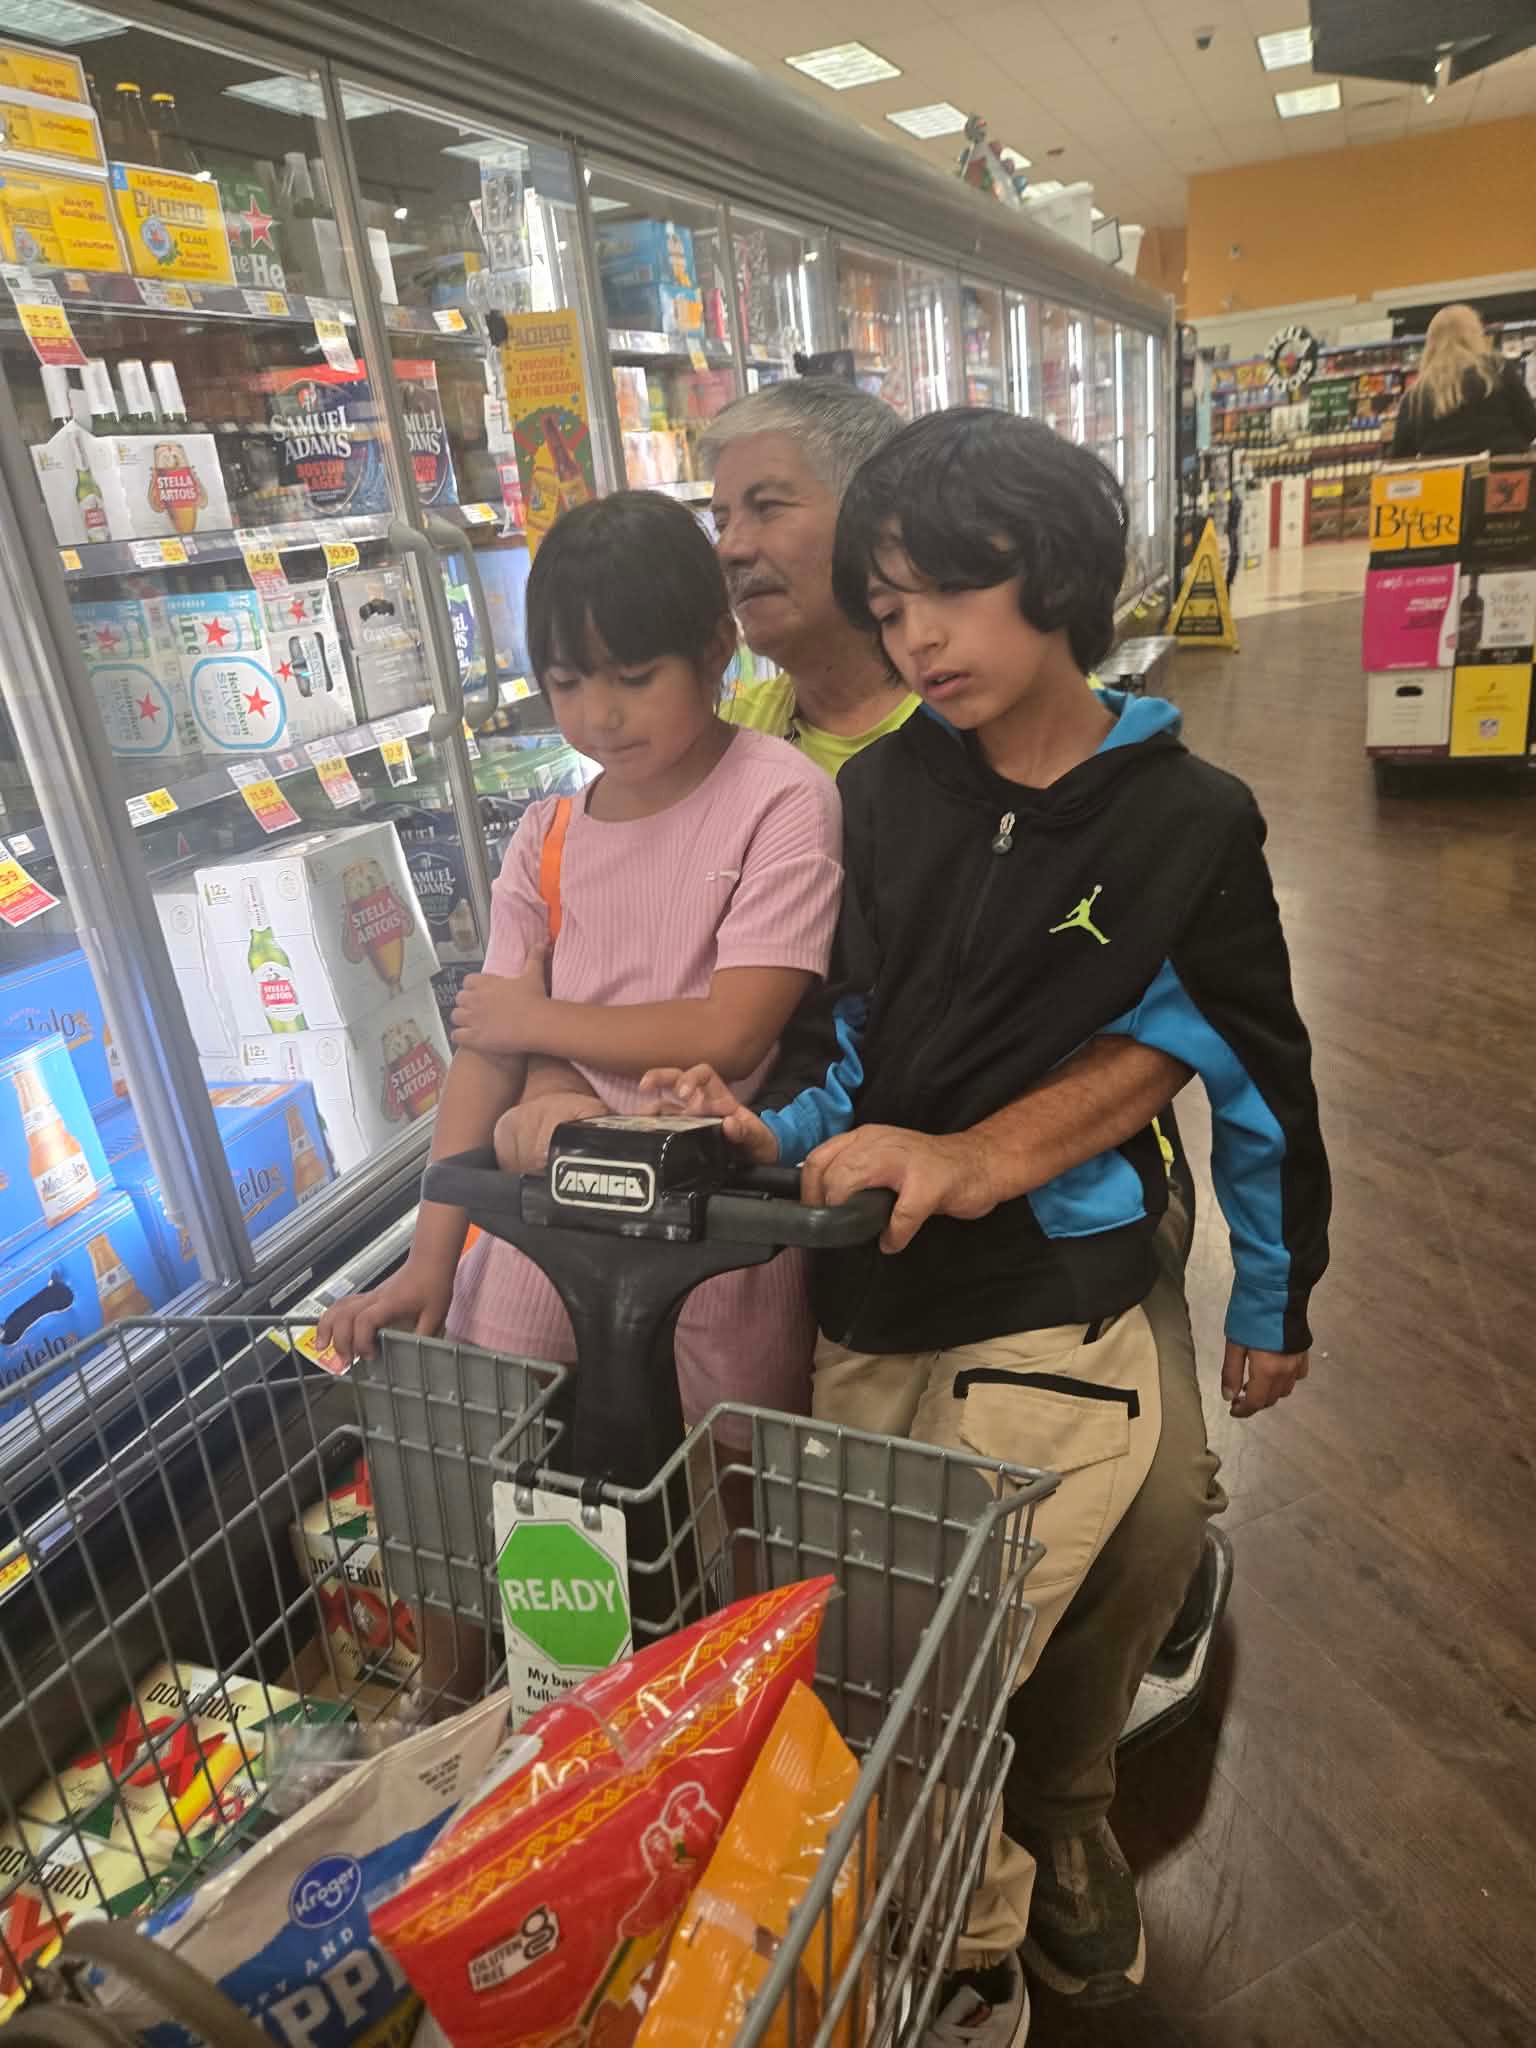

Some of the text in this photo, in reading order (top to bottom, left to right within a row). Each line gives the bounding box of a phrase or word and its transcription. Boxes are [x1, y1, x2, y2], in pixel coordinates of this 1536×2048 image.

[271, 404, 355, 442] SAMUEL
[403, 409, 442, 432] MUEL
[285, 432, 352, 465] ADAMS
[157, 473, 195, 489] STELLA
[159, 486, 197, 501] ARTOIS
[412, 867, 456, 883] AMUEL
[351, 896, 396, 929] STELLA
[356, 911, 402, 945] ARTOIS
[264, 984, 290, 994] STELLA
[391, 1051, 434, 1090] STELLA
[395, 1066, 438, 1104] ARTOIS
[239, 1167, 272, 1206] elo
[503, 1577, 617, 1614] READY
[527, 1666, 549, 1686] My
[296, 1866, 355, 1916] Kroger
[472, 1938, 523, 1975] GLUTEN
[475, 1966, 505, 1988] FREE
